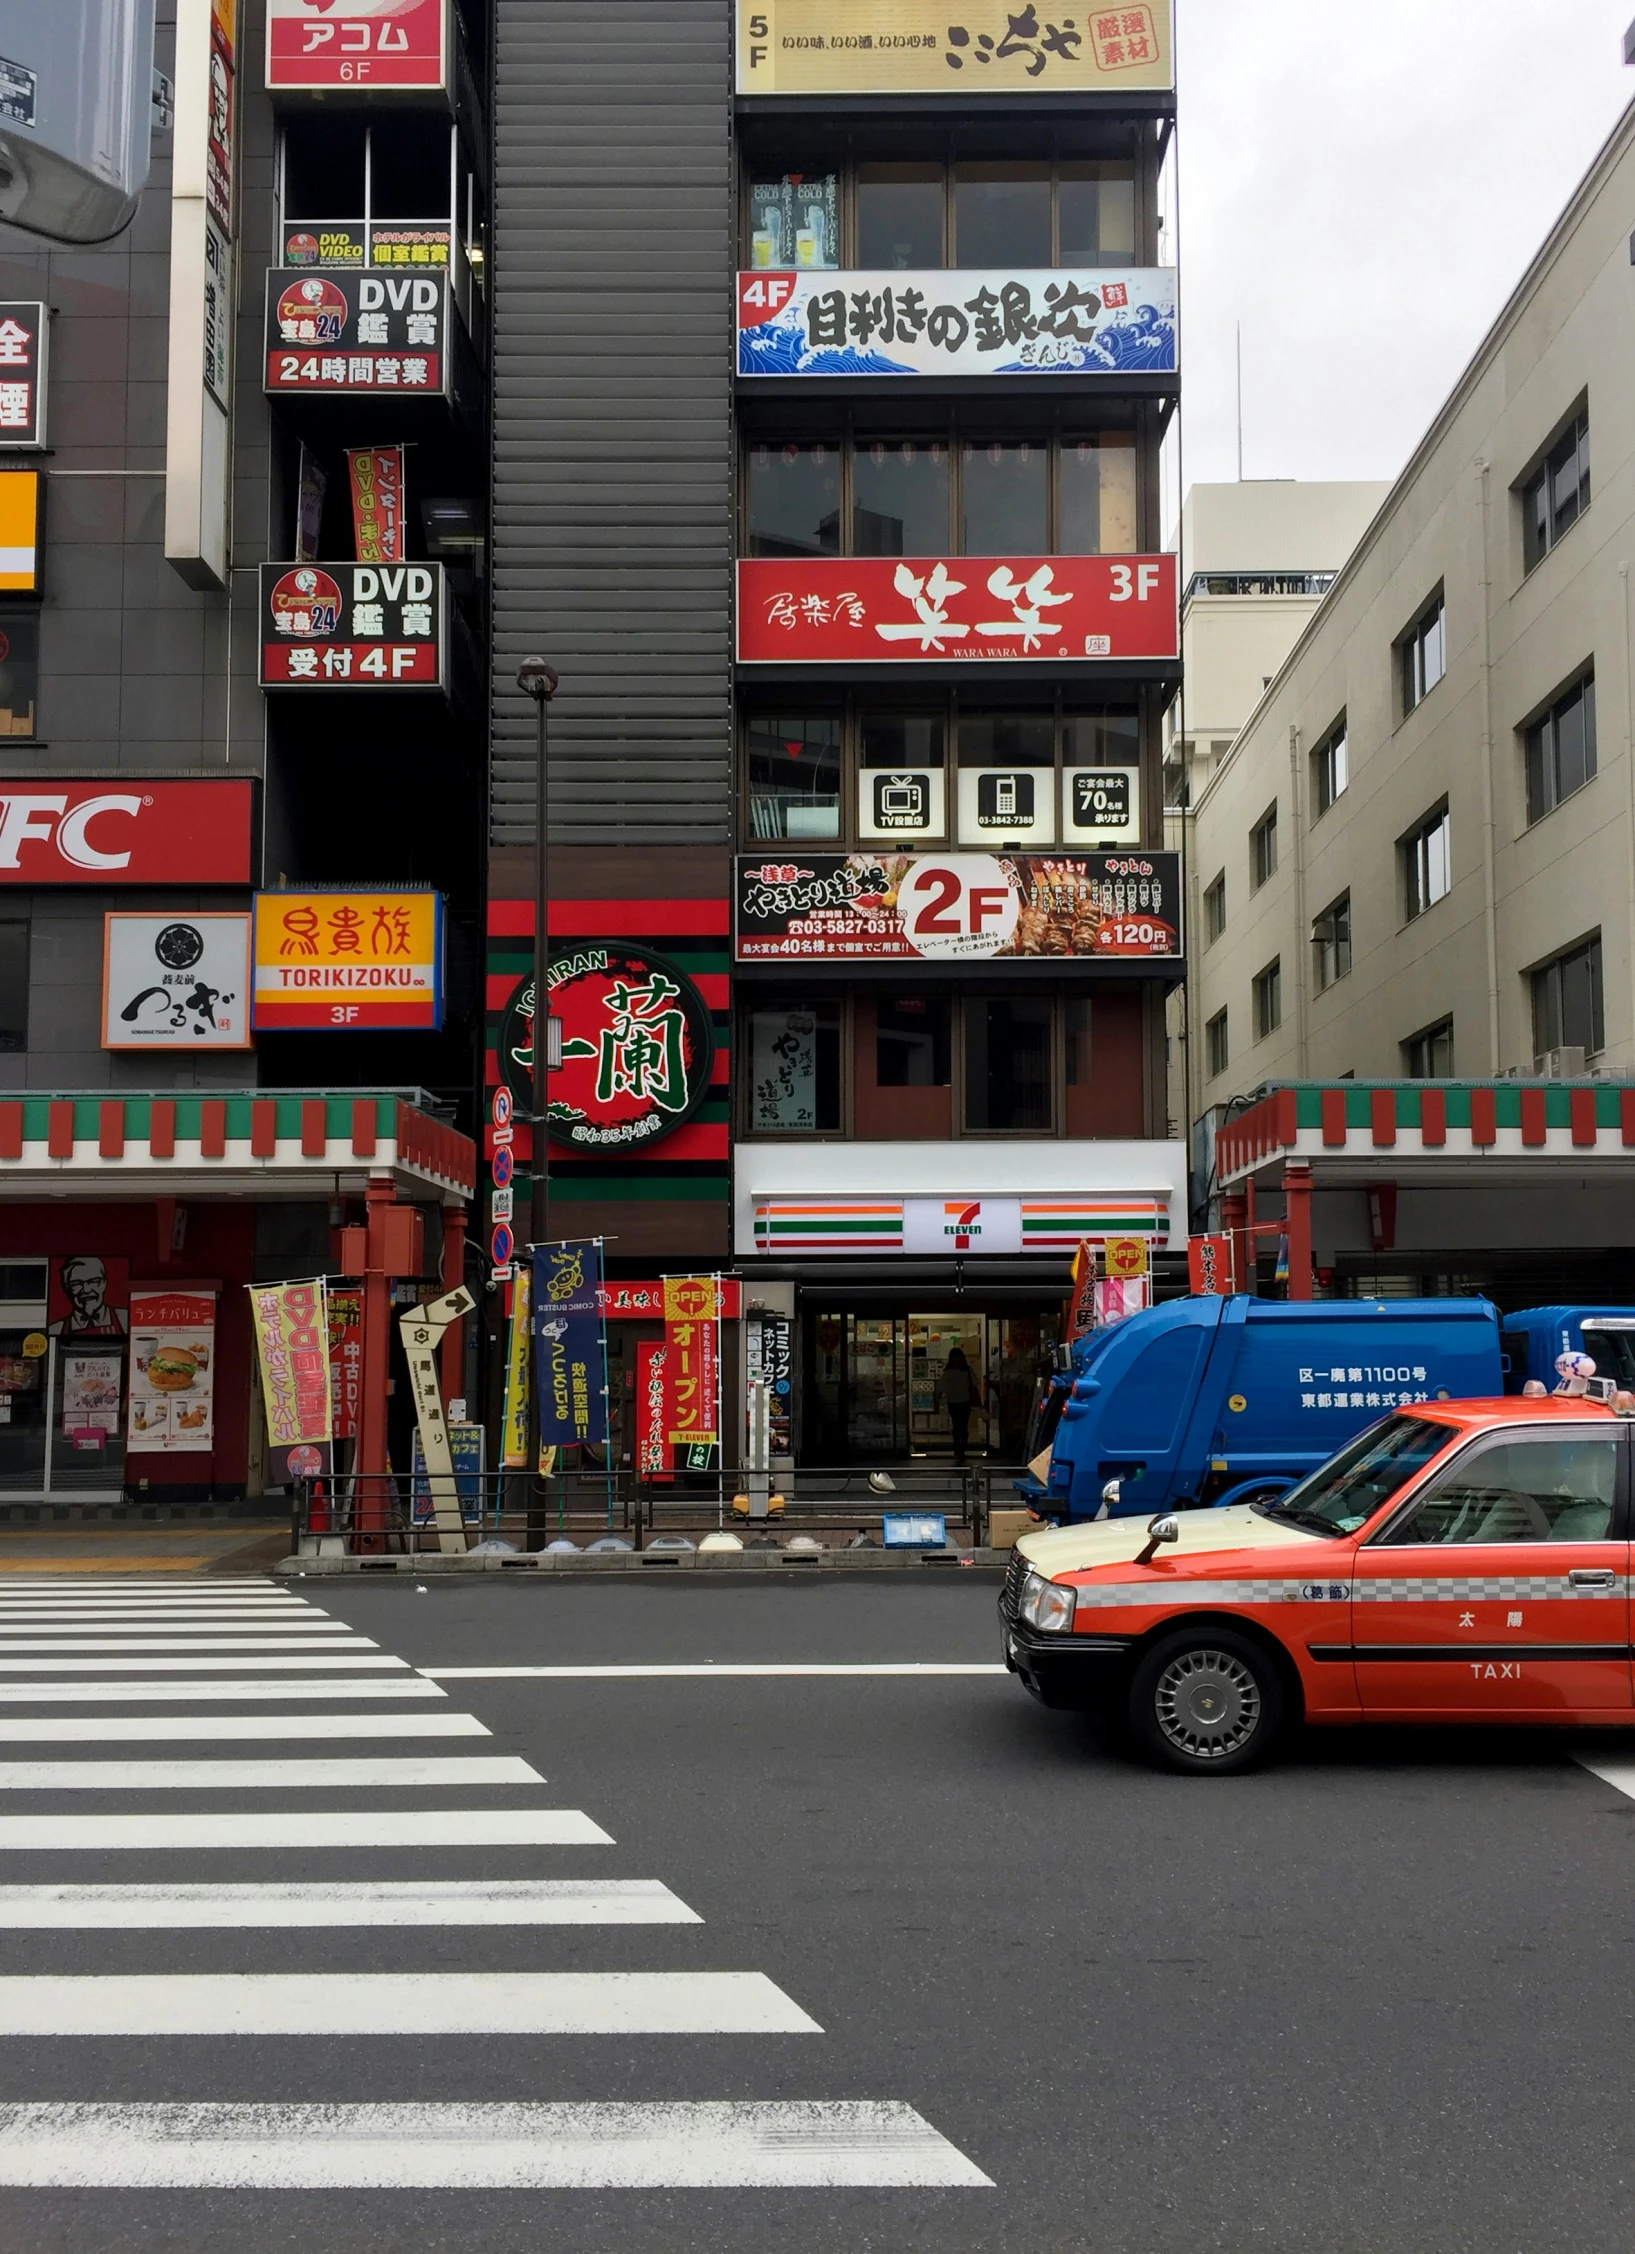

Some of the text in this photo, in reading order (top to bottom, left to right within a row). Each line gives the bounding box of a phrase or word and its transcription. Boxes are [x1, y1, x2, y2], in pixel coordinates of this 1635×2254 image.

[303, 22, 409, 52] アコム
[1102, 41, 1150, 65] 素材
[339, 62, 370, 81] 6F
[754, 190, 779, 200] COLD
[798, 190, 823, 199] COLD
[319, 233, 350, 245] DVD
[372, 231, 450, 243] ホテルがライバル
[319, 245, 364, 257] VIDEO
[373, 244, 449, 263] 個室鑑賞
[359, 278, 438, 311] DVD
[742, 280, 790, 307] 4F
[806, 280, 1101, 352] 目利きの銀次
[357, 312, 438, 345] 鑑賞
[280, 357, 428, 384] 24時間営業
[353, 568, 433, 601] DVD
[1109, 564, 1159, 601] 3F
[875, 562, 1073, 653] 笑笑
[352, 603, 433, 636] 鑑賞
[288, 647, 417, 678] 受付4F
[953, 648, 1018, 658] WARA WARA
[1077, 778, 1124, 789] ご宴会最大
[880, 815, 924, 827] TV設置店
[979, 815, 1033, 825] 03-3842-7388
[1094, 813, 1128, 824] 承ります
[1042, 859, 1087, 876] やきとり
[1105, 858, 1153, 876] やきとん
[743, 866, 890, 919] やきとり道場
[914, 868, 1009, 935] 2F
[809, 909, 843, 919] 営業時間
[279, 906, 411, 956] 鳥貴族
[803, 919, 905, 935] 03-5827-0317
[279, 967, 412, 987] TORIKIZOKU
[515, 950, 608, 1018] ICIRAN
[330, 1006, 359, 1023] 3F
[511, 973, 689, 1113] 一蘭
[797, 1108, 813, 1120] 2F
[571, 1115, 662, 1143] 昭和35年創業
[1109, 1249, 1144, 1260] OPEN
[1200, 1244, 1217, 1294] 熊本名
[669, 1291, 713, 1303] OPEN
[134, 1308, 211, 1321] ランチバリュー
[776, 1322, 790, 1379] コミック
[673, 1323, 698, 1428] オープン
[1299, 1366, 1427, 1382] 区一廃第1100号
[1471, 1664, 1521, 1679] TAXI
